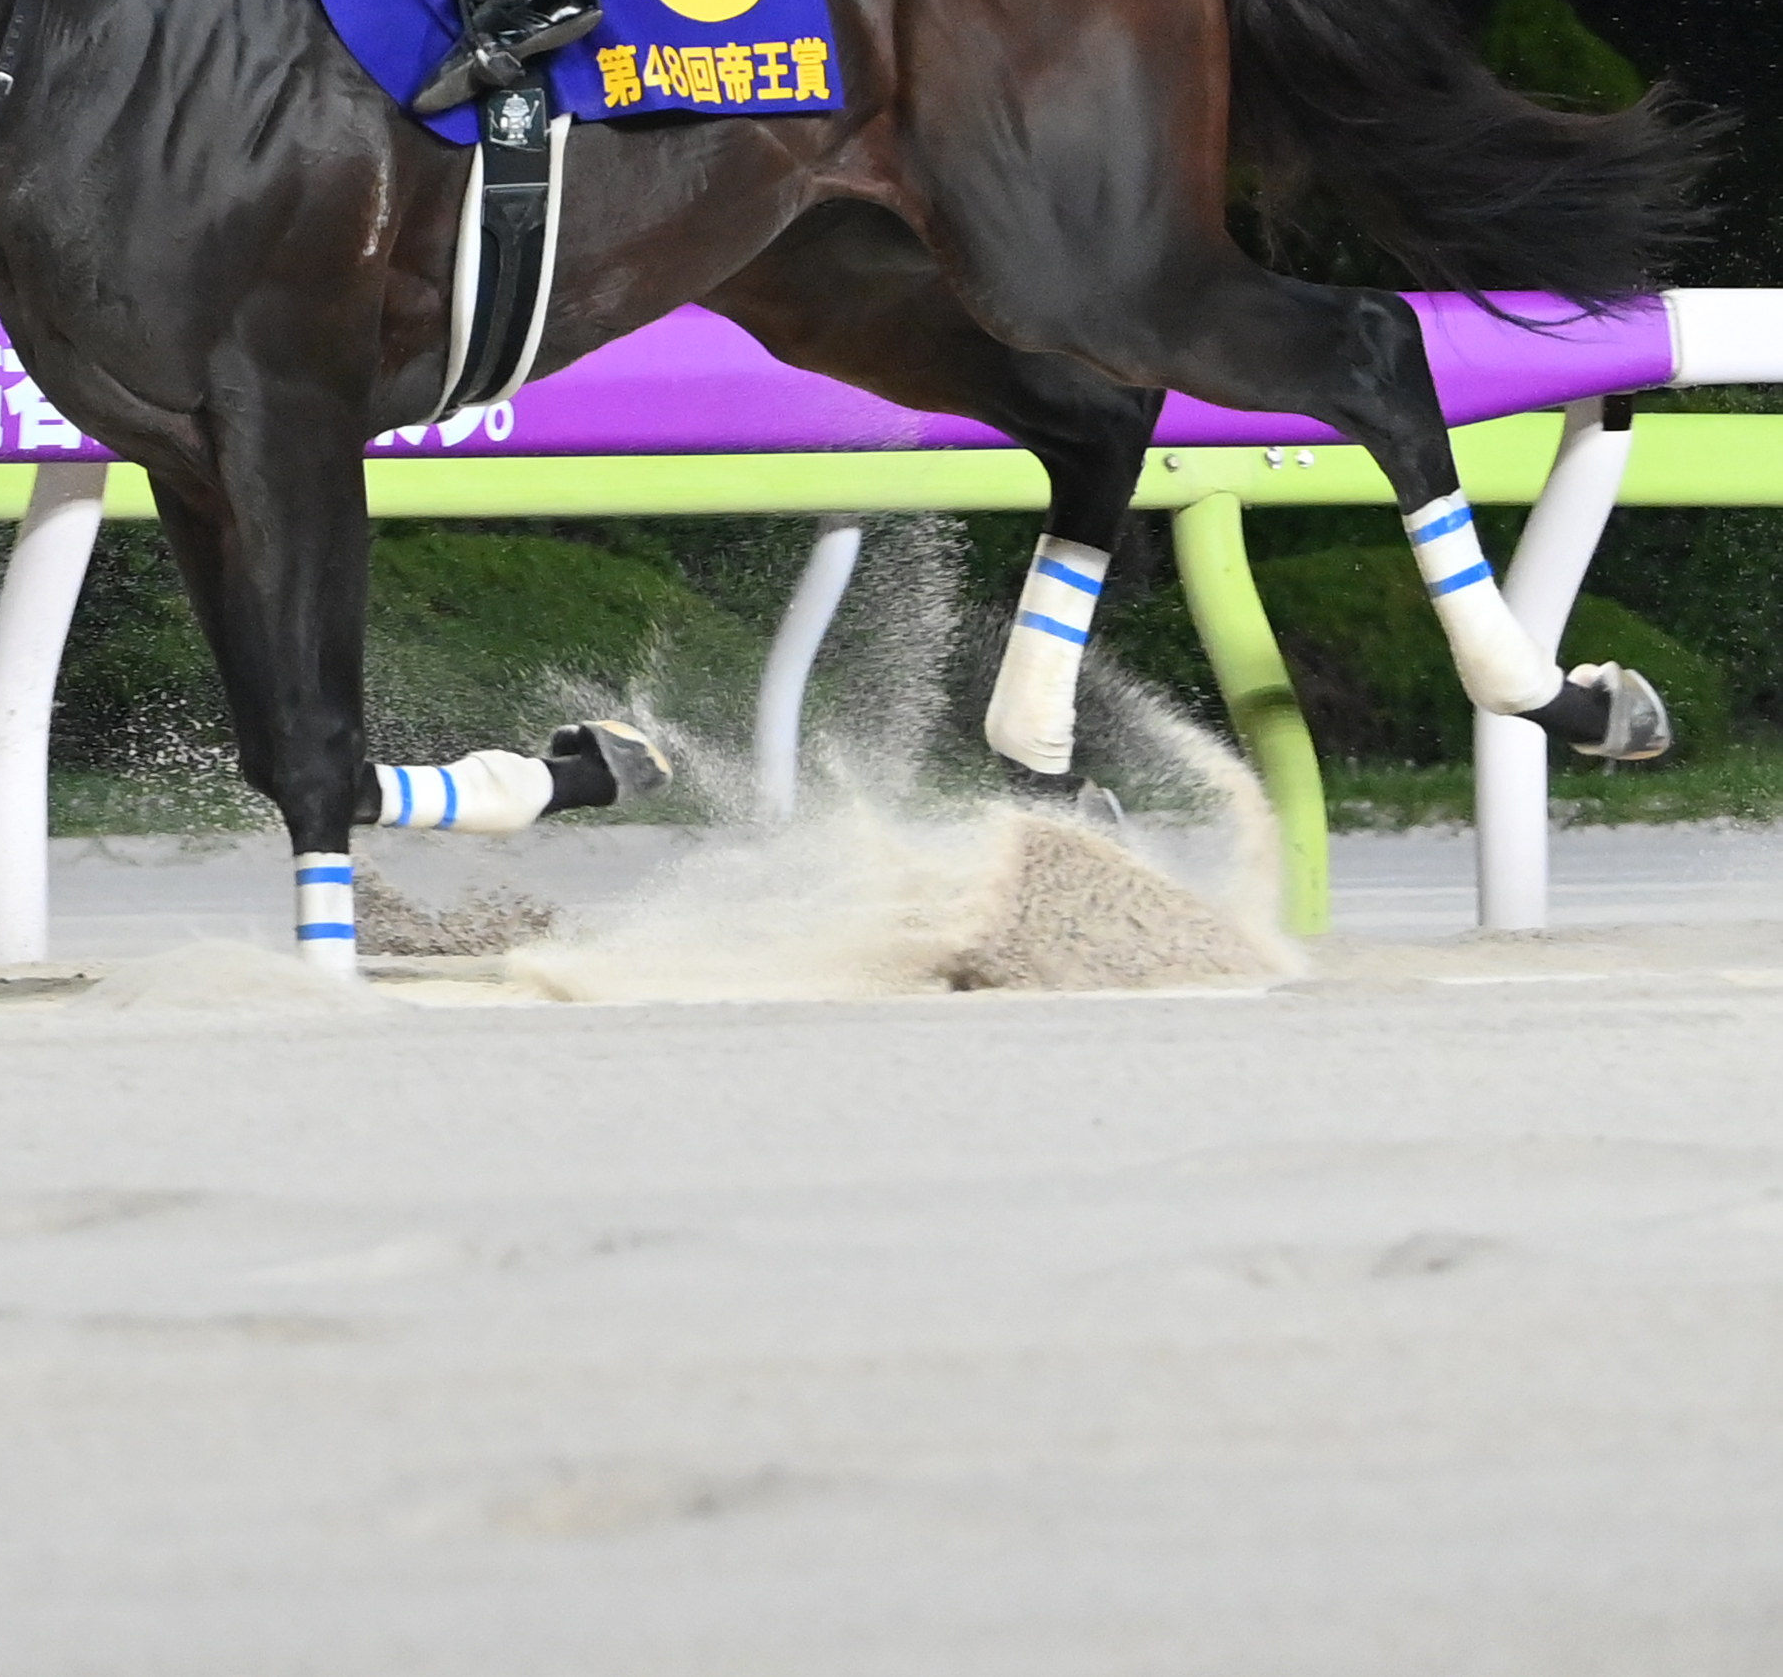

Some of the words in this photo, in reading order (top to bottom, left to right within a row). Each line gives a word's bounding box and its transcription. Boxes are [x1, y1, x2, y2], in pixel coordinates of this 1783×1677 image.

[596, 37, 831, 108] 第48回帝王賞
